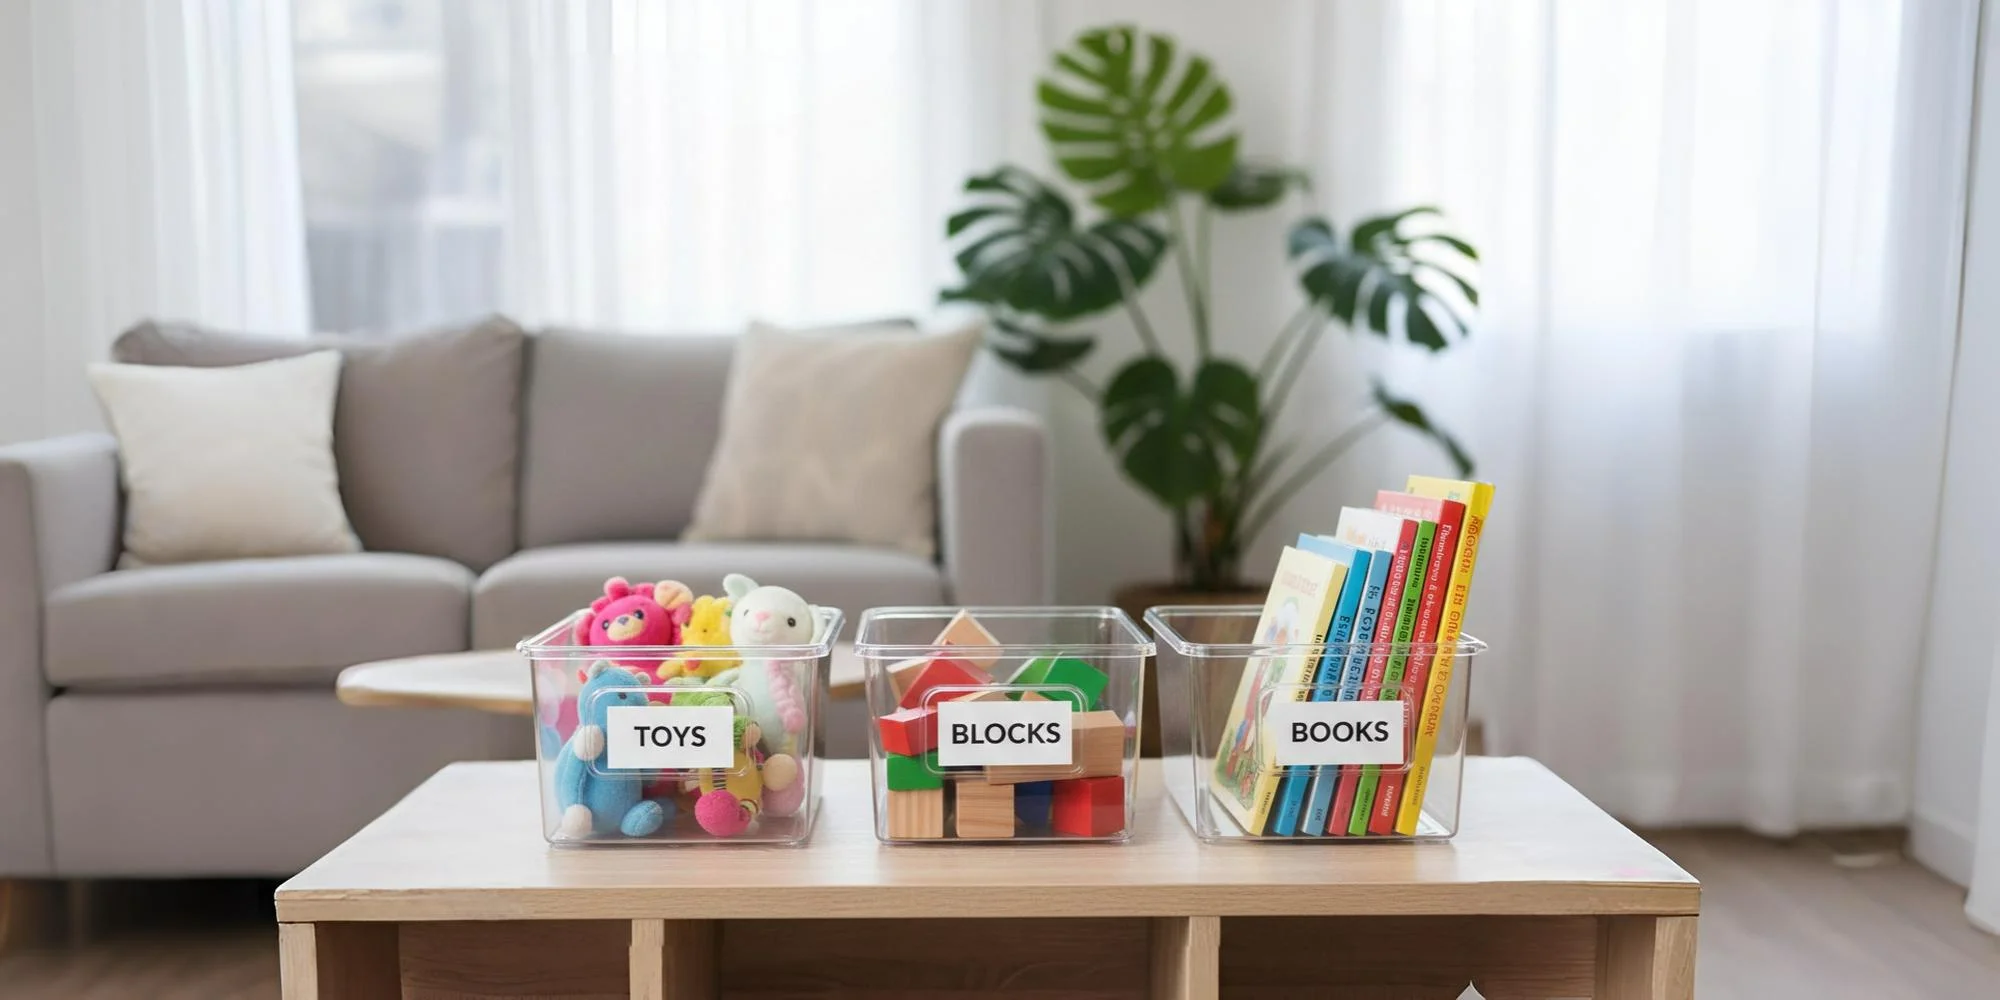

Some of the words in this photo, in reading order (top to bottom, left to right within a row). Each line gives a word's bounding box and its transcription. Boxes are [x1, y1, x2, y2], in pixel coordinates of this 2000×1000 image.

[634, 725, 706, 748] TOYS
[952, 722, 1061, 745] BLOCKS
[1292, 720, 1389, 743] BOOKS
